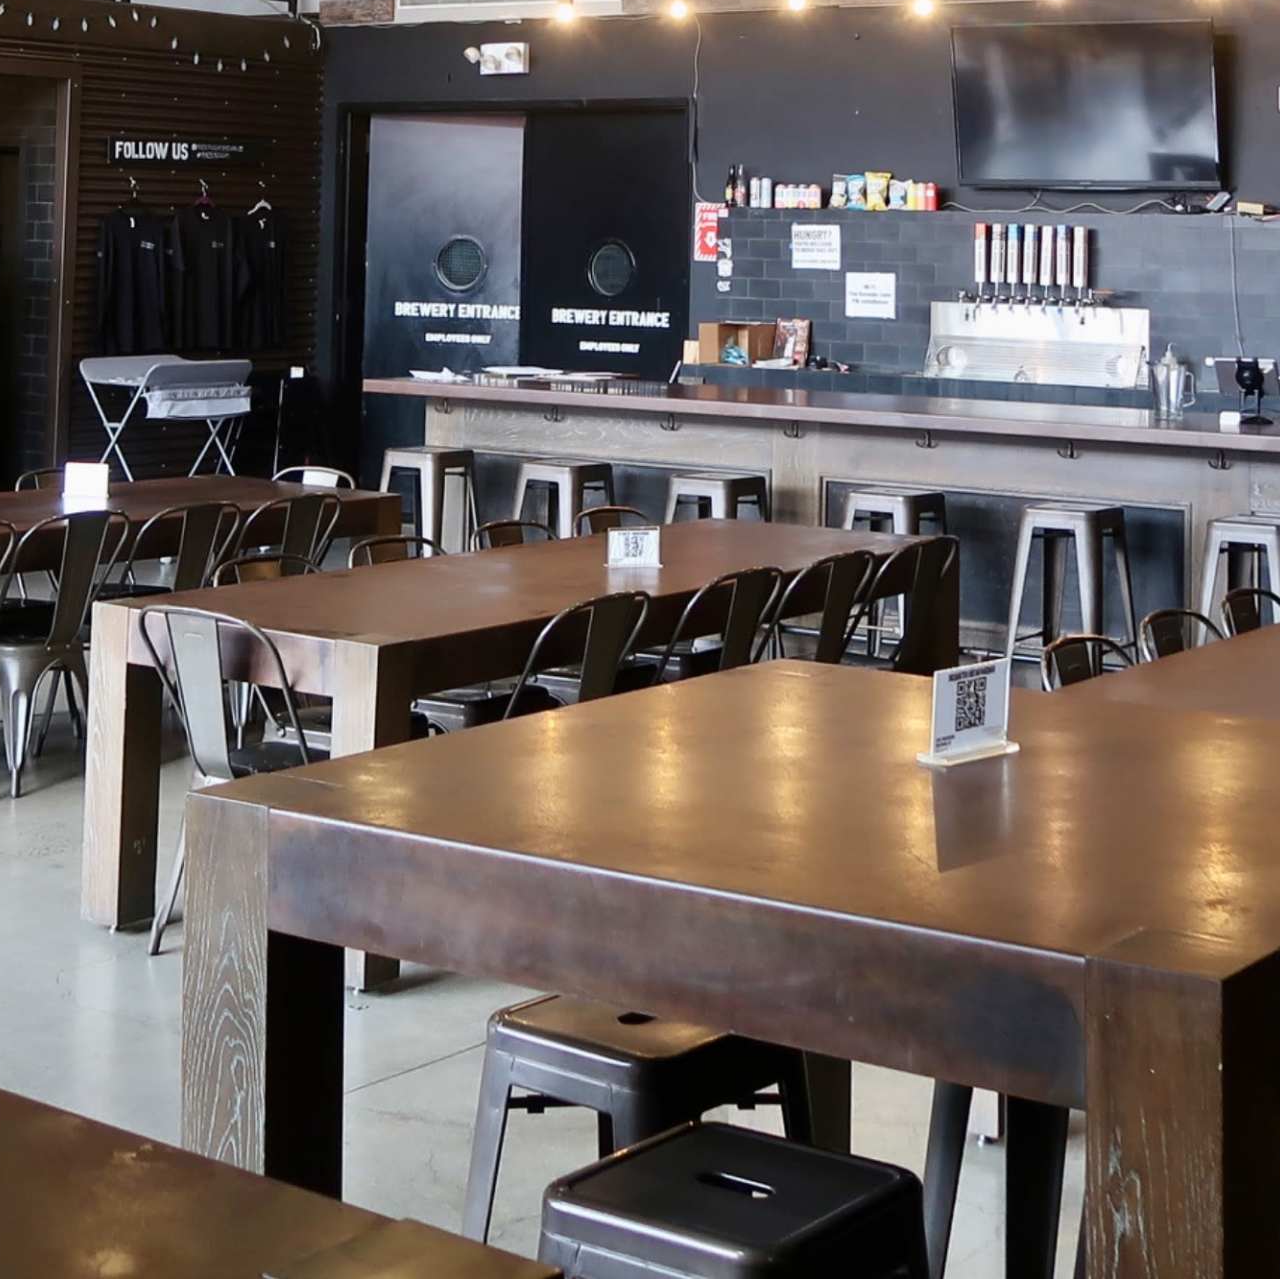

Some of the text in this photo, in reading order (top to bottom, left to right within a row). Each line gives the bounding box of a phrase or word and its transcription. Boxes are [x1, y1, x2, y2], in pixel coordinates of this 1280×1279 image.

[115, 141, 169, 160] FOLLOW
[172, 143, 189, 160] US
[395, 301, 520, 320] BREWERY ENTRANCE
[552, 308, 670, 328] BREWERY ENTRANCE
